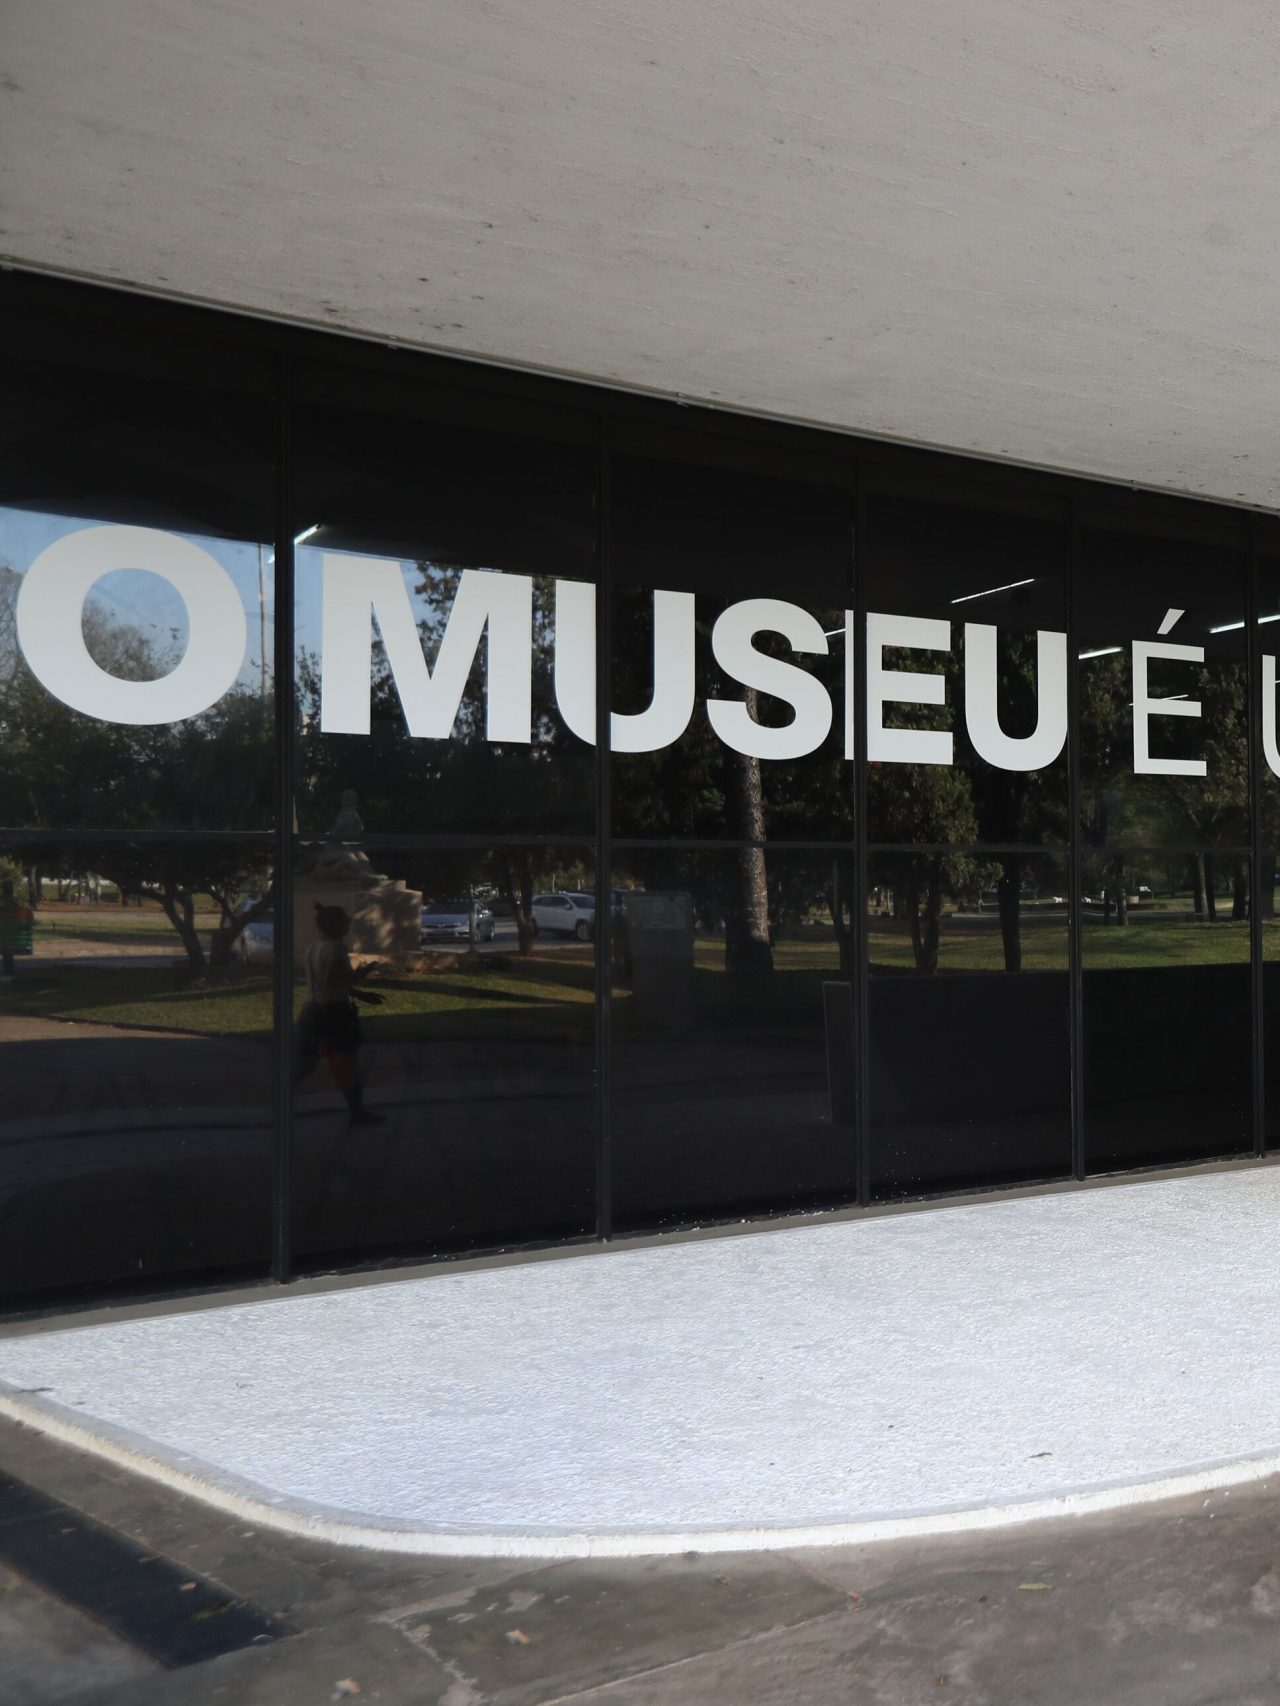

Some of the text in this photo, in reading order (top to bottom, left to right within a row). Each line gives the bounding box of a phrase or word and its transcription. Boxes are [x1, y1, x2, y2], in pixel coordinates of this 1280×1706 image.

[16, 525, 247, 725] O
[321, 553, 1067, 772] MUSEU
[1132, 608, 1208, 777] É
